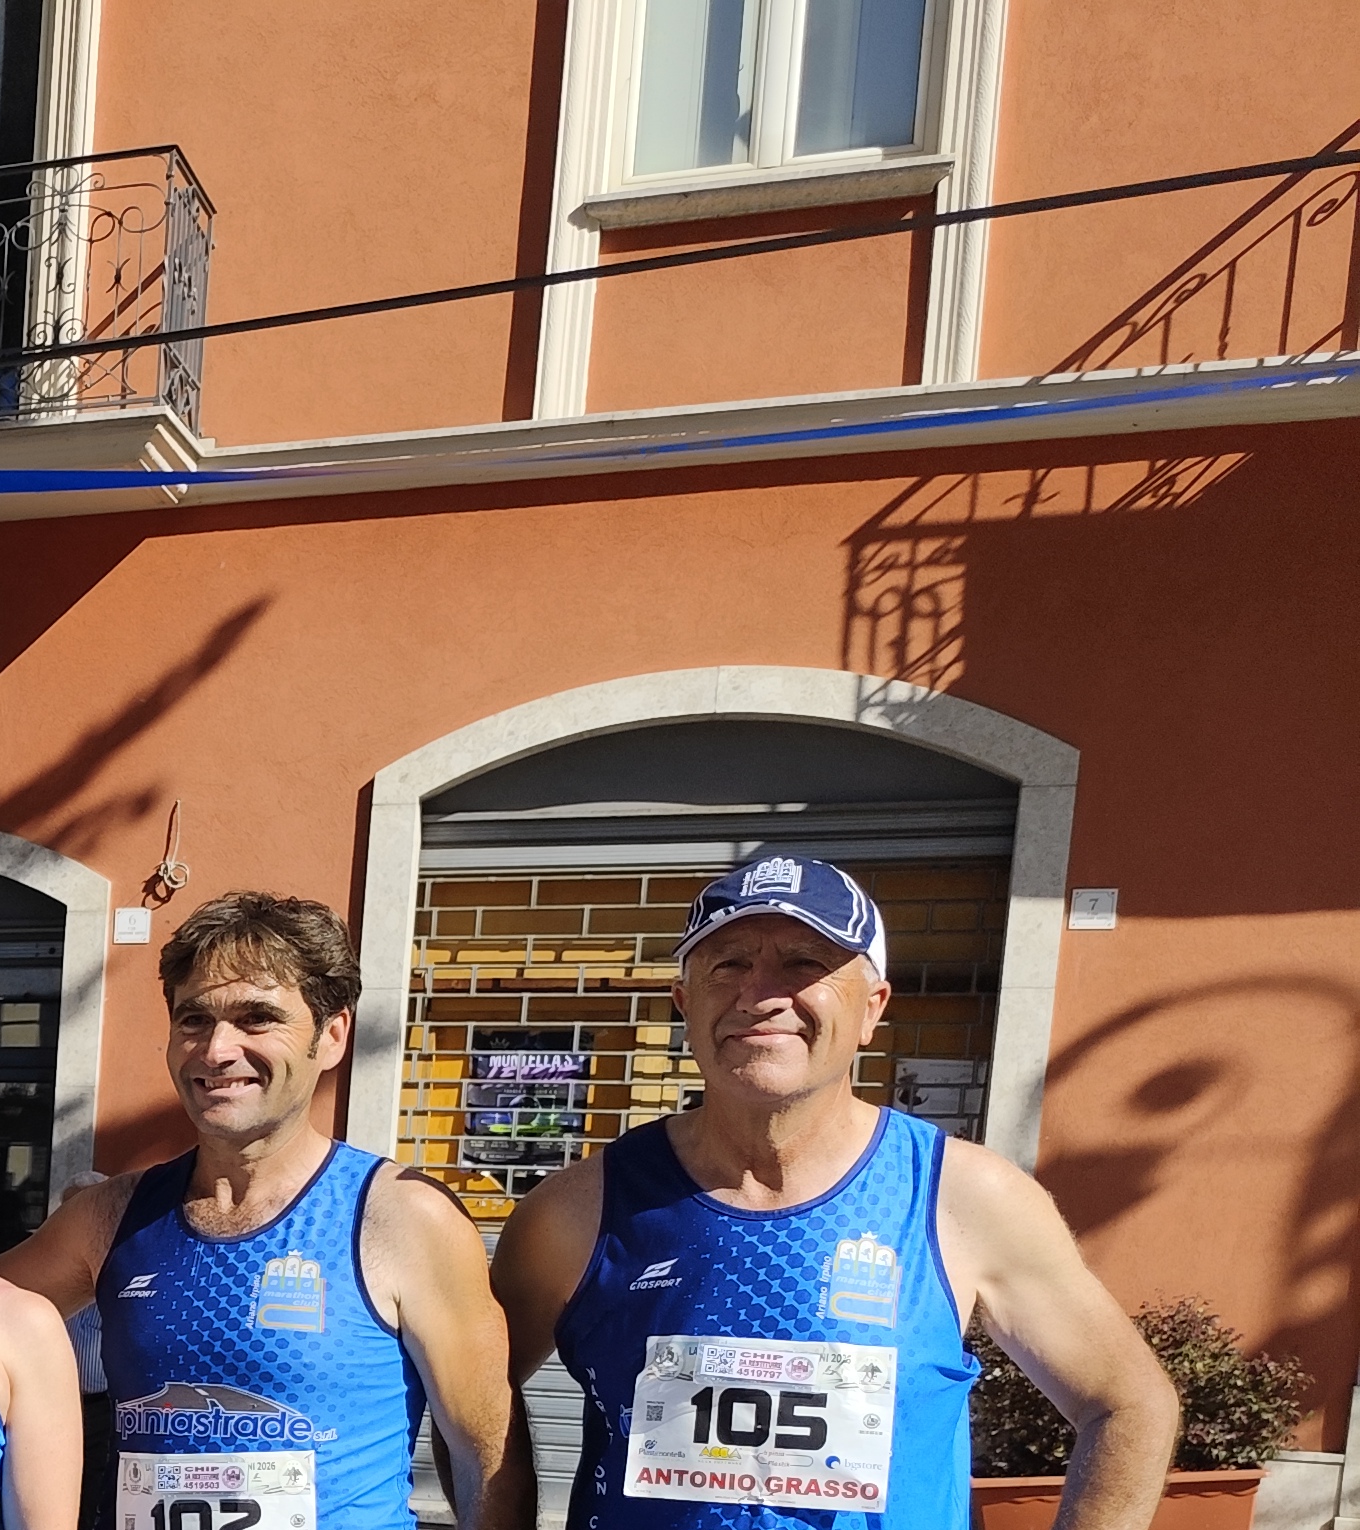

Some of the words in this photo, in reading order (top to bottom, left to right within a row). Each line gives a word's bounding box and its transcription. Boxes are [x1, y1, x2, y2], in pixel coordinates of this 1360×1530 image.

[1088, 898, 1100, 911] 7
[128, 914, 137, 926] 6
[629, 1278, 682, 1291] GIOSPORT
[835, 1276, 895, 1290] marathon
[263, 1291, 320, 1300] marathon
[867, 1288, 894, 1298] club
[292, 1299, 319, 1307] club
[739, 1351, 784, 1360] CHIP
[736, 1368, 783, 1380] 4519797
[690, 1386, 828, 1451] 105
[313, 1428, 339, 1442] s.r.l.
[698, 1445, 742, 1460] ACCA
[257, 1462, 276, 1471] 2026
[844, 1459, 883, 1471] bgstore
[183, 1481, 220, 1490] 4519503
[636, 1467, 755, 1492] ANTONIO
[764, 1476, 879, 1501] GRASSO
